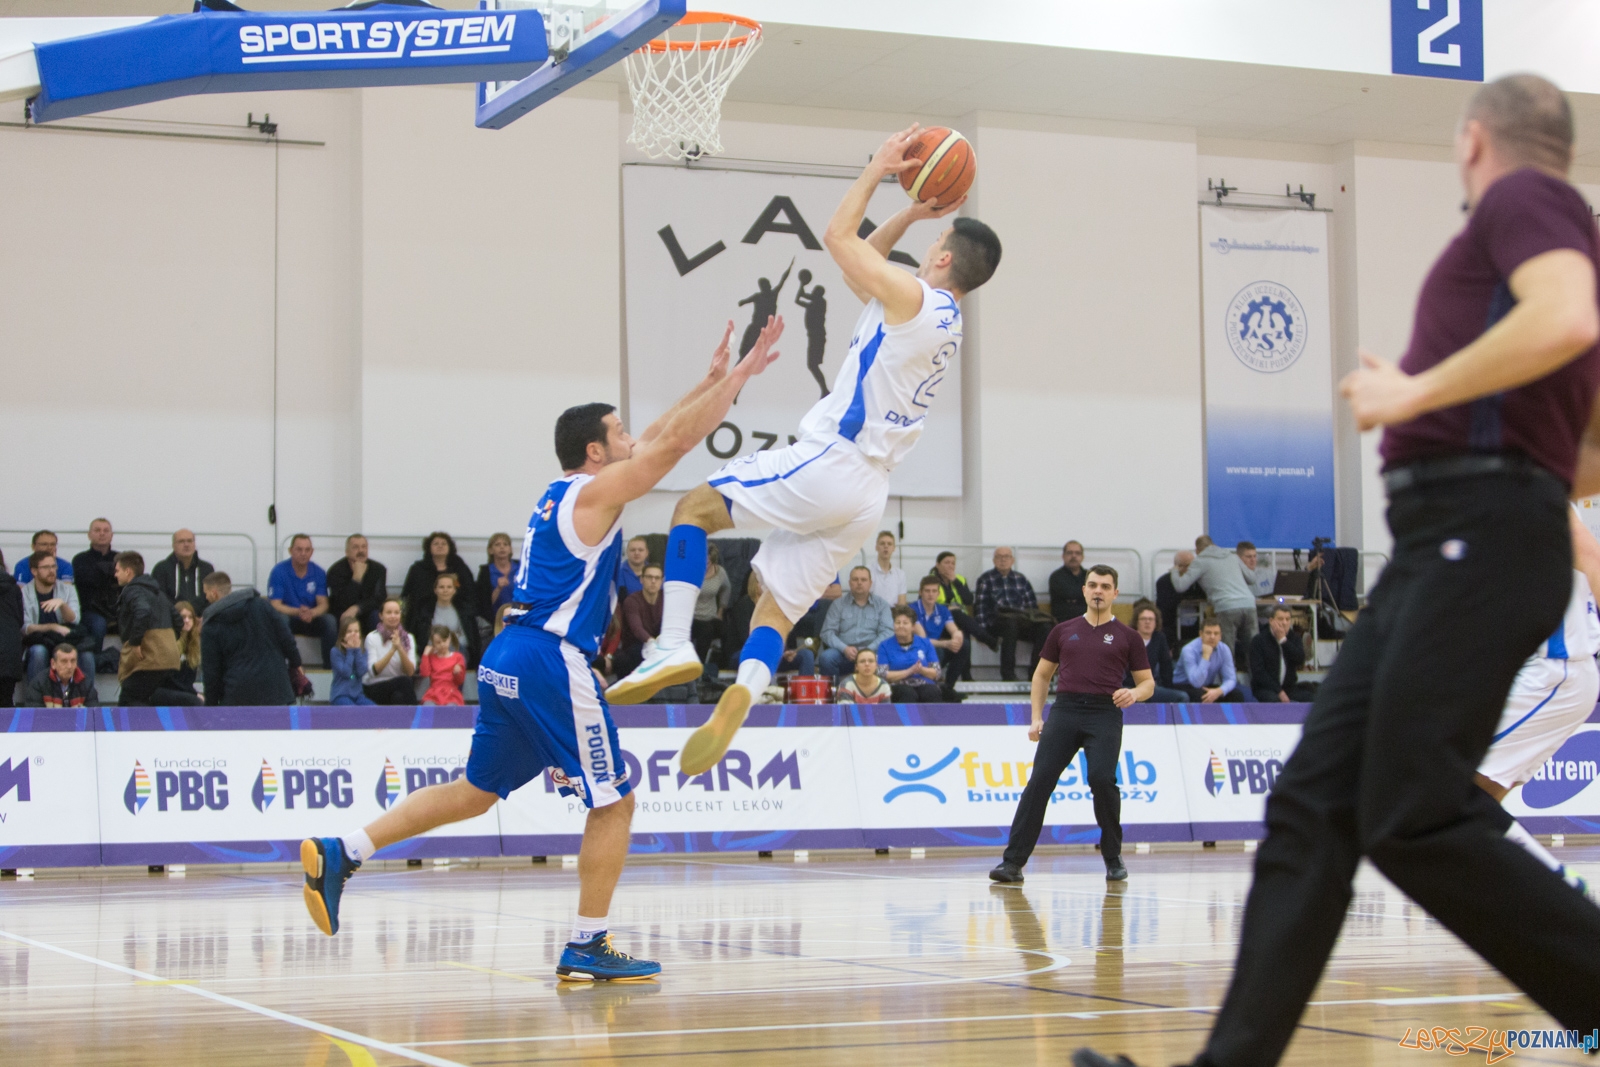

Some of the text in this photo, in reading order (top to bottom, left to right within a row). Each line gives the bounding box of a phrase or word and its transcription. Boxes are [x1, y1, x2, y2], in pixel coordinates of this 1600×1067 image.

[1417, 0, 1461, 67] 2
[1226, 466, 1315, 478] www.azs.put.poznan.pl
[1224, 748, 1282, 758] fundacja
[154, 757, 227, 769] fundacja
[280, 756, 351, 768] fundacja
[156, 770, 229, 811] PBG
[282, 769, 354, 810] PBG
[733, 798, 784, 812] LEKÓW
